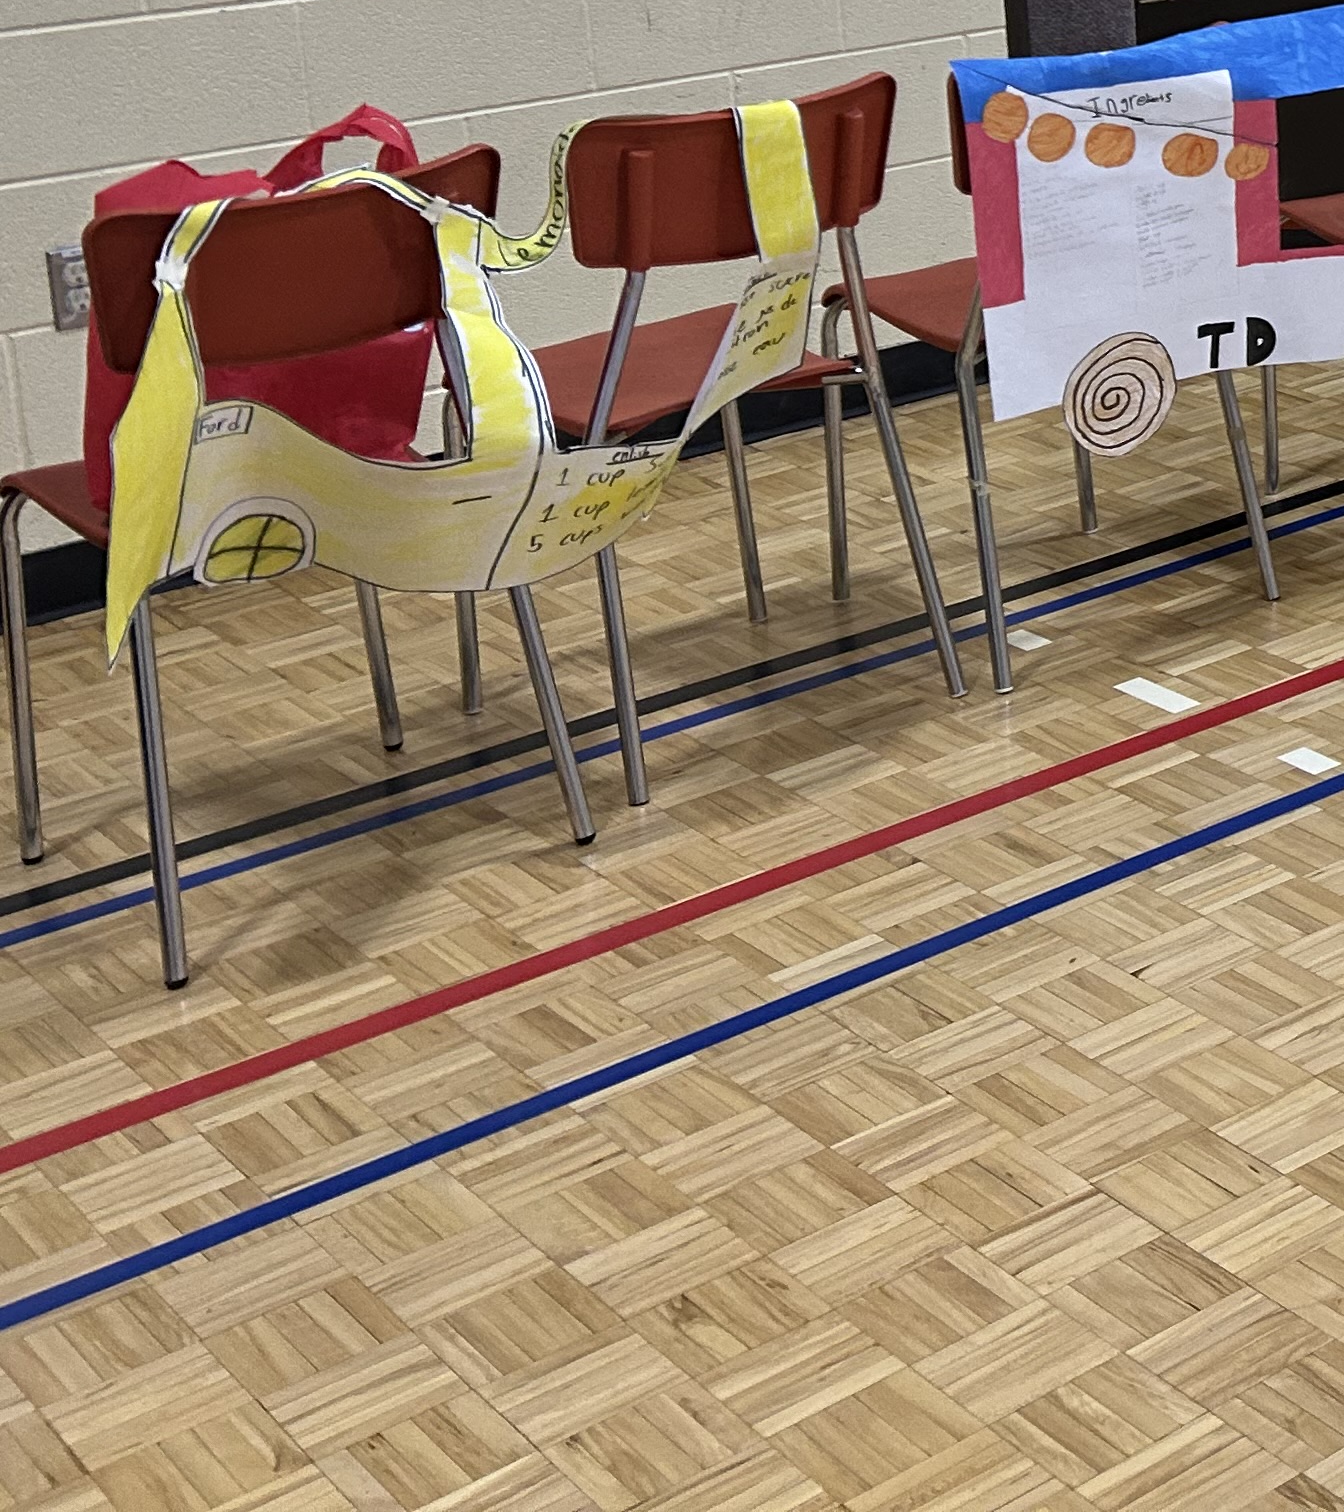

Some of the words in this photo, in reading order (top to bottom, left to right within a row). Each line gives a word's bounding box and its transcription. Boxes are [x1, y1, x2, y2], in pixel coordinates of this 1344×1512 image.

[199, 408, 243, 438] Ford
[556, 467, 569, 487] 1
[587, 468, 626, 488] cup
[538, 503, 559, 523] 1
[573, 500, 610, 521] cup
[526, 533, 545, 553] 5
[559, 524, 603, 546] cups
